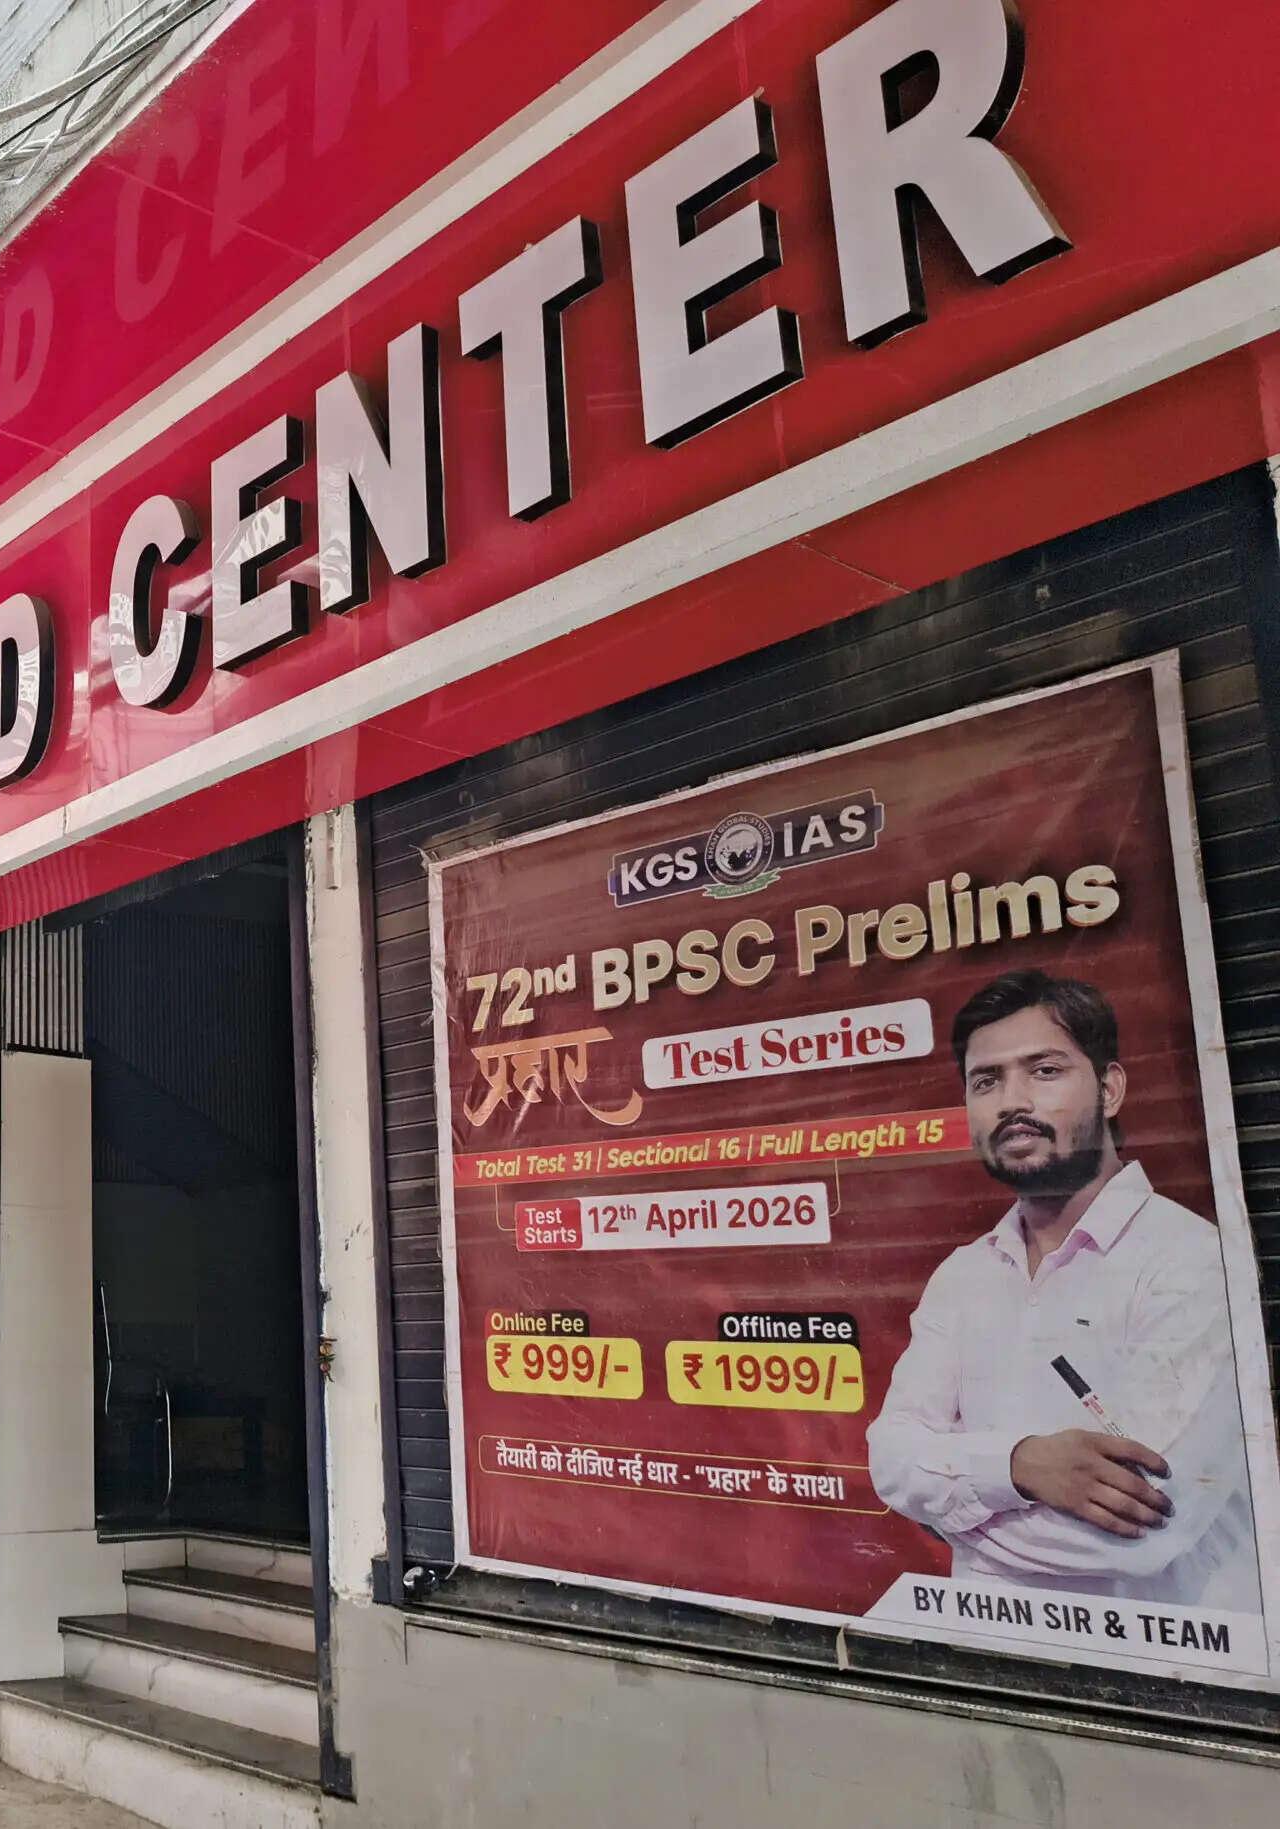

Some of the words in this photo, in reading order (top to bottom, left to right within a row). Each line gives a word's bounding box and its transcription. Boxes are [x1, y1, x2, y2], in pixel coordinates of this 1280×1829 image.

[108, 0, 1074, 708] CENTER
[620, 846, 698, 896] KGS
[783, 804, 868, 858] IAS
[466, 954, 576, 1032] 72nd
[591, 919, 776, 1012] BPSC
[794, 864, 1120, 976] Prelims
[664, 1036, 752, 1081] Test
[761, 1016, 906, 1068] Series
[463, 1026, 643, 1127] प्रहार
[476, 1156, 520, 1179] Total
[526, 1153, 566, 1175] Test
[572, 1150, 593, 1172] 31
[607, 1138, 711, 1169] Sectional
[717, 1137, 741, 1160] 16
[759, 1129, 804, 1157] Full
[810, 1120, 906, 1158] Length
[915, 1119, 944, 1144] 15
[524, 1208, 562, 1224] Test
[524, 1227, 577, 1245] Starts
[588, 1204, 637, 1233] 12th
[646, 1200, 717, 1238] April
[726, 1195, 816, 1228] 2026
[490, 1312, 547, 1332] Online
[551, 1313, 585, 1333] Fee
[722, 1316, 802, 1338] Offline
[808, 1317, 853, 1339] Fee
[522, 1343, 629, 1389] 999/-
[715, 1354, 859, 1400] 1999/-
[495, 1439, 537, 1470] तैयारी
[540, 1445, 562, 1473] को
[565, 1447, 614, 1478] दीजिए
[617, 1453, 643, 1485] नई
[646, 1461, 678, 1484] धार
[765, 1464, 788, 1494] के
[913, 1586, 945, 1614] BY
[956, 1591, 1033, 1626] KHAN
[1043, 1602, 1092, 1635] SIR
[1104, 1609, 1127, 1640] &
[1137, 1614, 1230, 1653] TEAM
